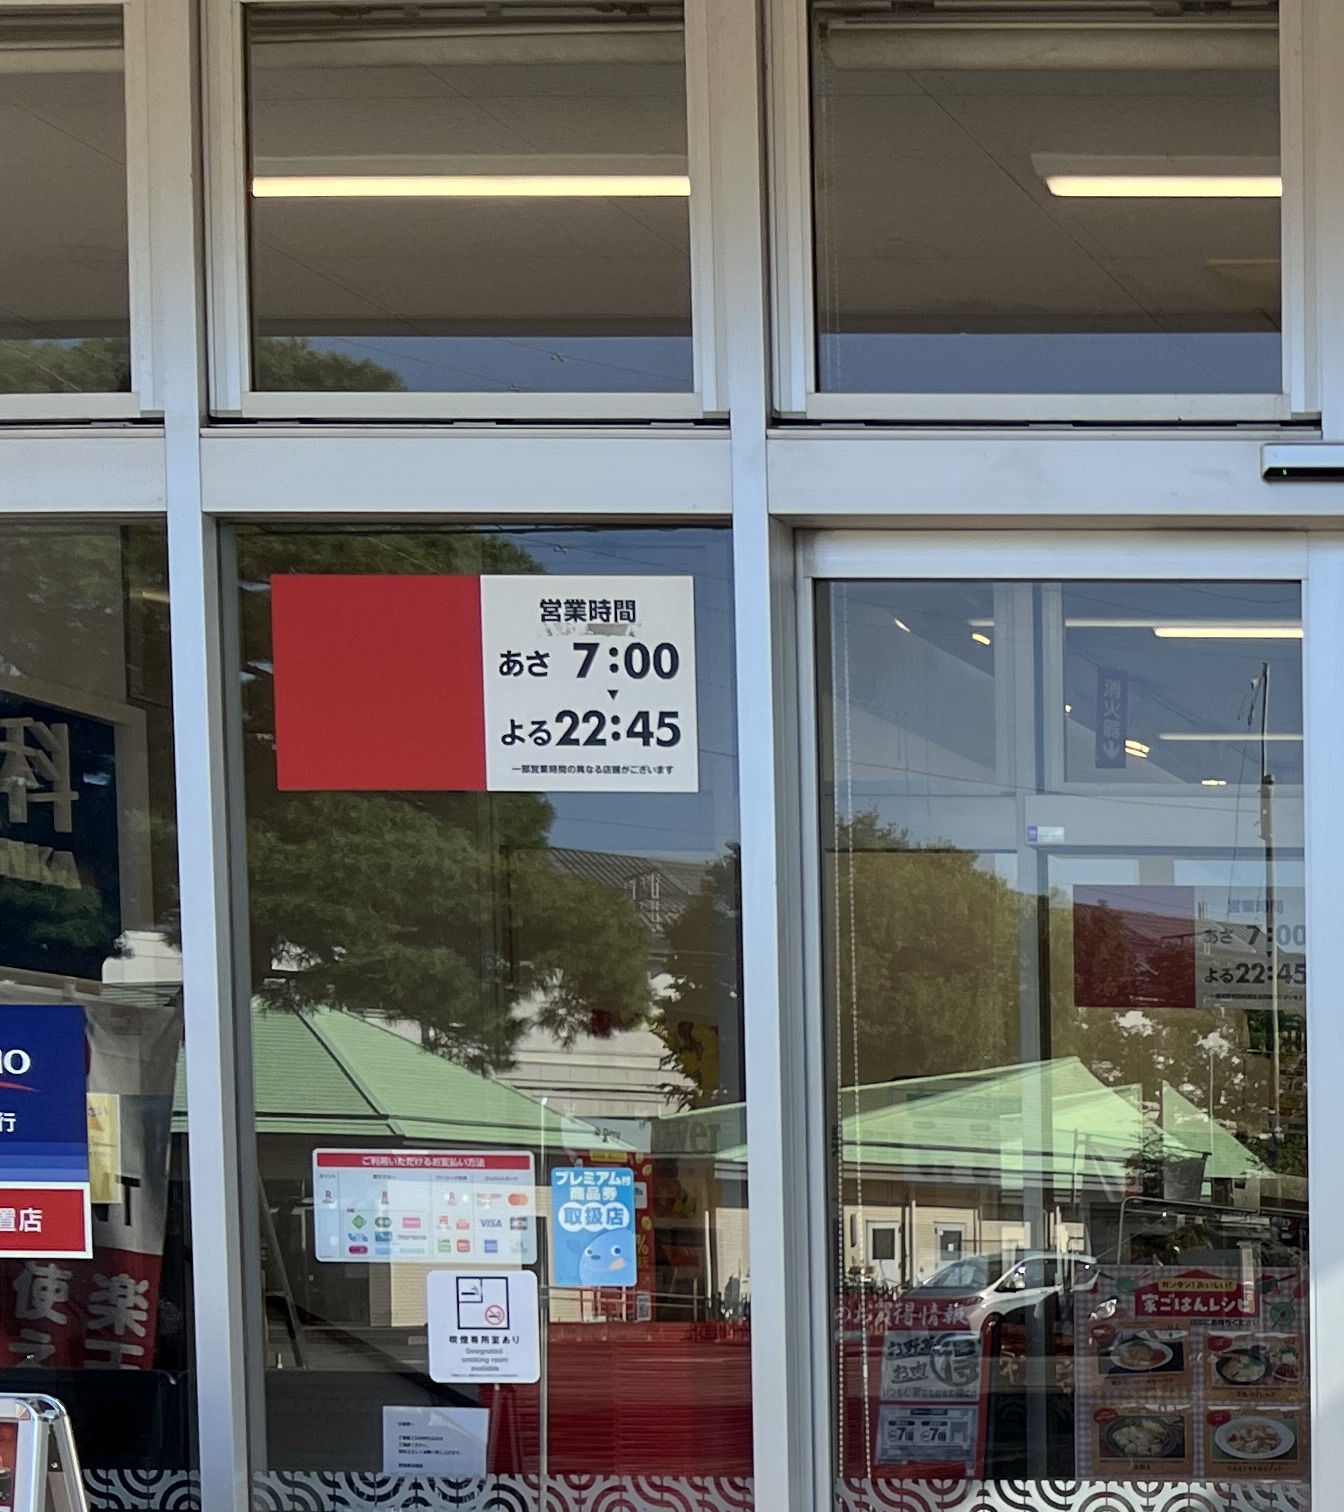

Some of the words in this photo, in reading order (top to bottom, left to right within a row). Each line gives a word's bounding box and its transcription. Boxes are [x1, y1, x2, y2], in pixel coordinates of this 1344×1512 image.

[540, 599, 636, 623] 営業時間
[499, 650, 551, 678] あさ
[572, 642, 680, 680] 7:00
[500, 718, 552, 746] よる
[555, 709, 682, 748] 22:45
[1204, 966, 1235, 985] よる
[569, 1186, 618, 1201] 商品券
[563, 1207, 625, 1227] 取扱店
